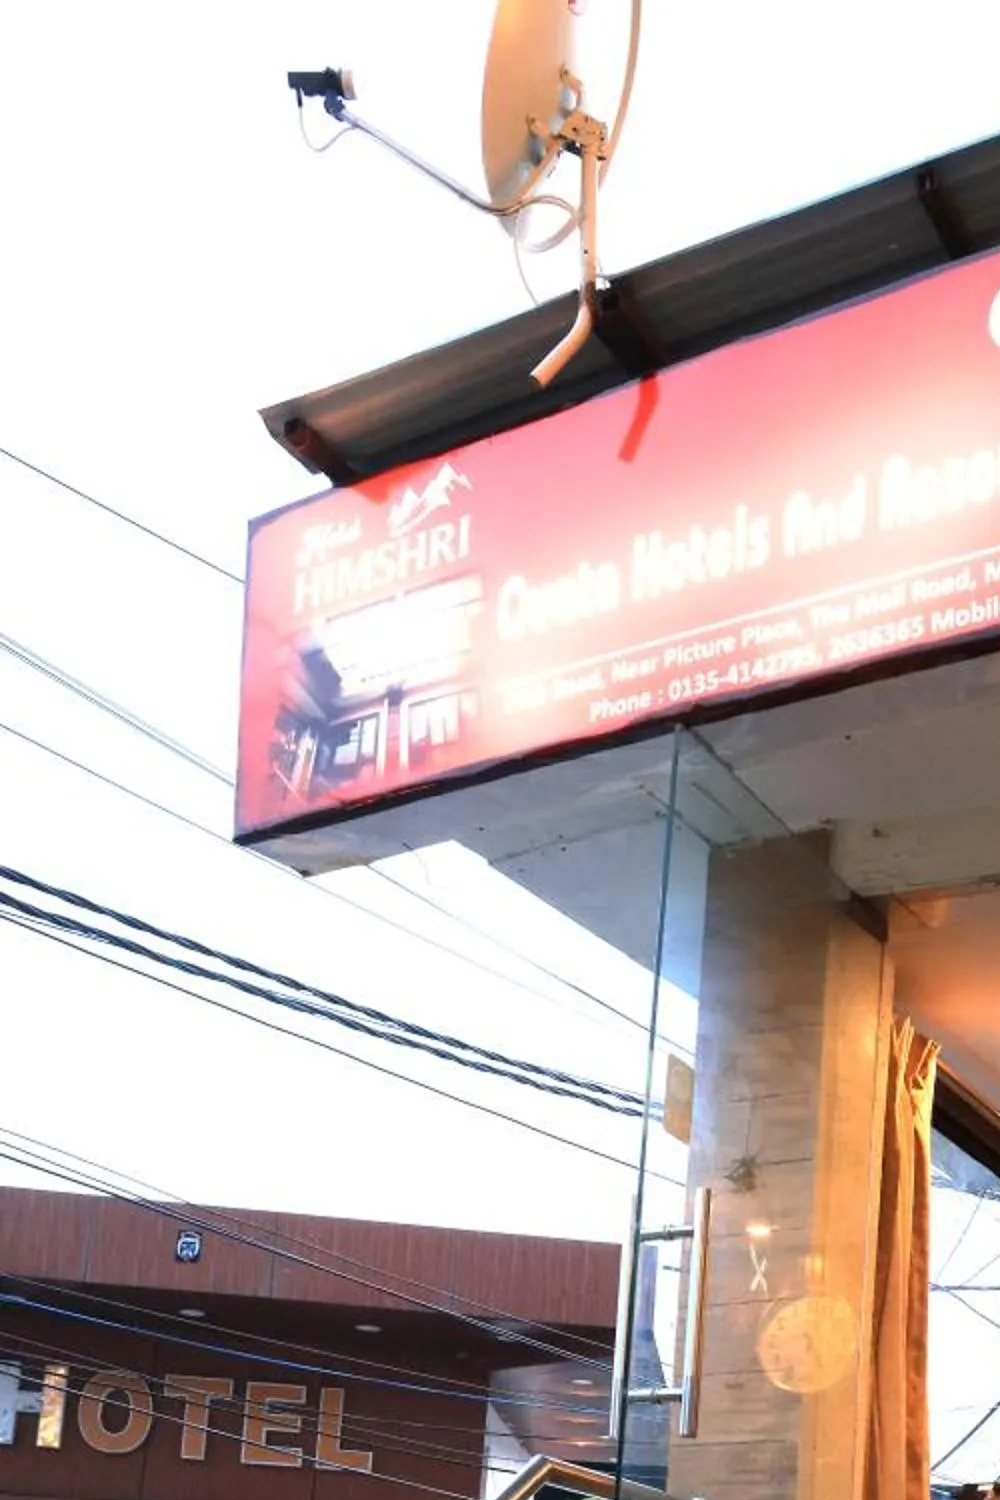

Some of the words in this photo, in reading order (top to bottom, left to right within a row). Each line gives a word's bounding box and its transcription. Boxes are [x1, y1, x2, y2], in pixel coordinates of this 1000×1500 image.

[293, 513, 471, 616] HIMSHRI
[630, 502, 770, 600] Hotels
[664, 636, 737, 673] Picture
[911, 570, 977, 603] Road,
[589, 688, 651, 722] Phone
[0, 1359, 374, 1475] HOTEL
